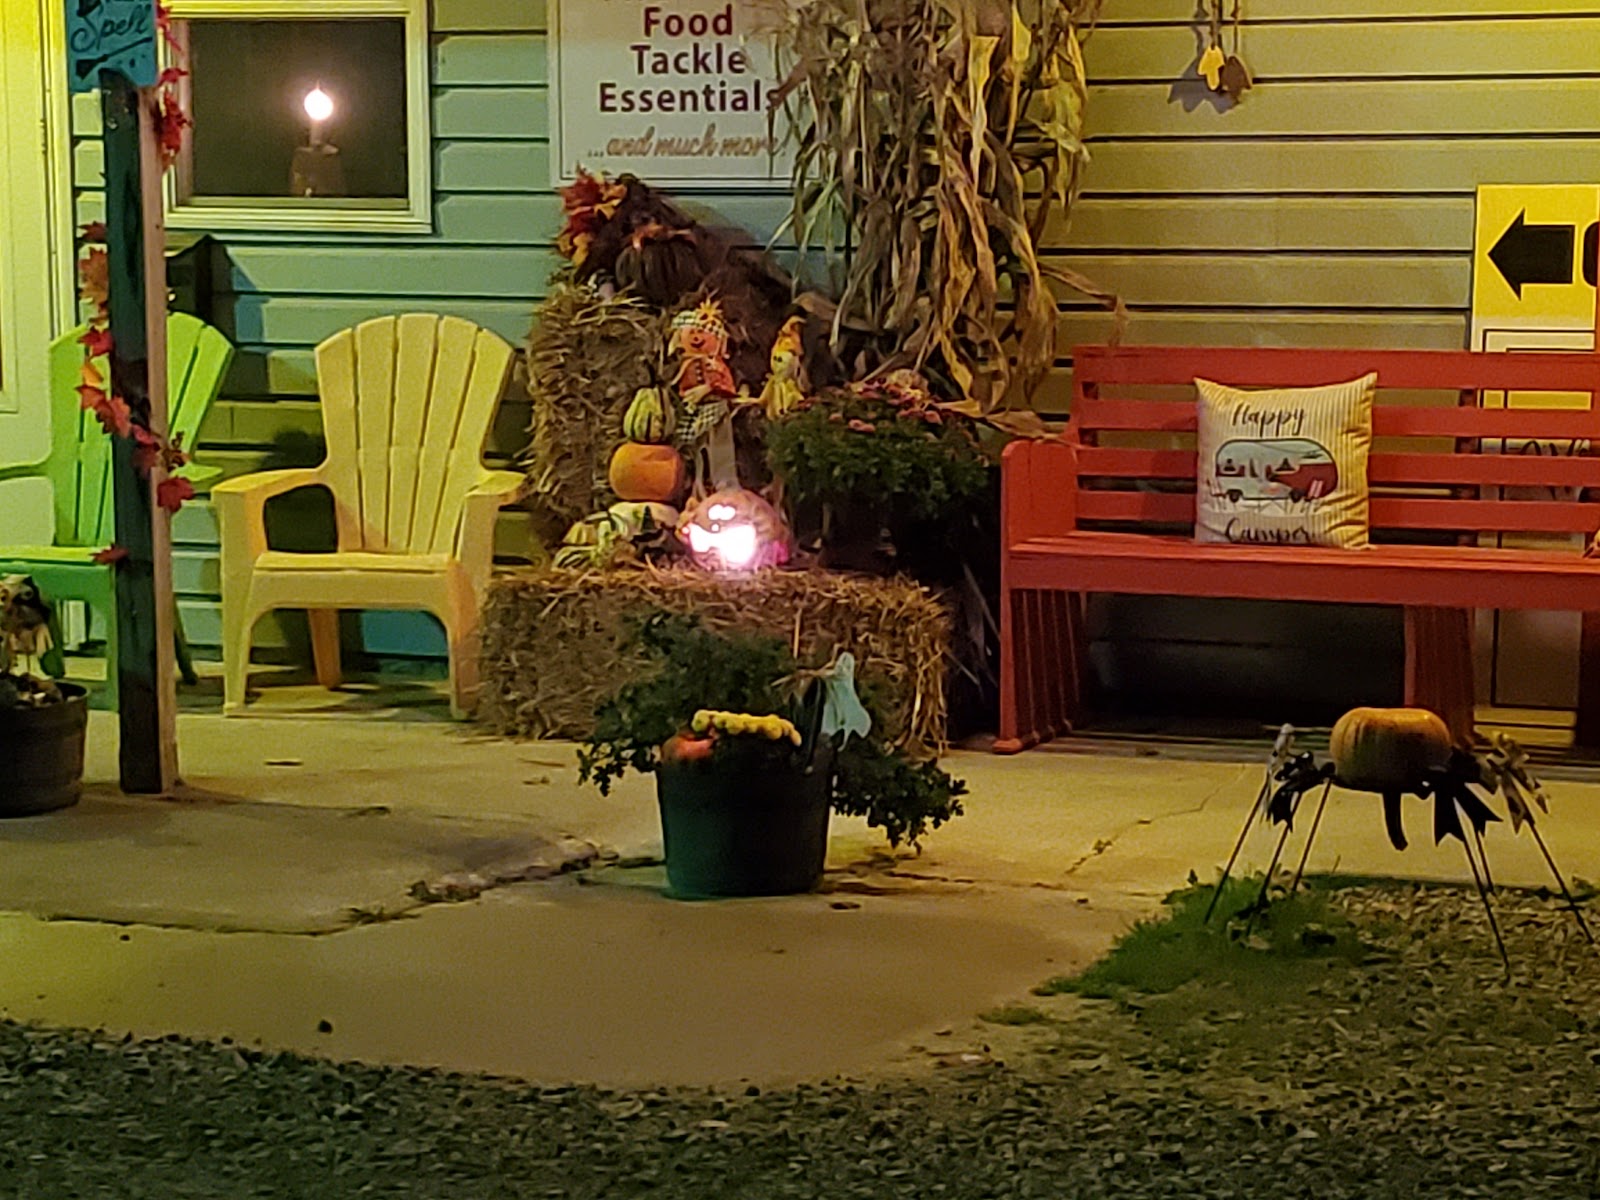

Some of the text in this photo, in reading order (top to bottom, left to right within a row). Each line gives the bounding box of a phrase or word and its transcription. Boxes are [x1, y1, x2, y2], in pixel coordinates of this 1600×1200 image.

[70, 4, 152, 53] Spell
[643, 3, 734, 38] Food
[630, 42, 747, 75] Tackle
[653, 122, 719, 158] much
[1231, 402, 1305, 437] Happy
[1225, 516, 1312, 544] Camper
